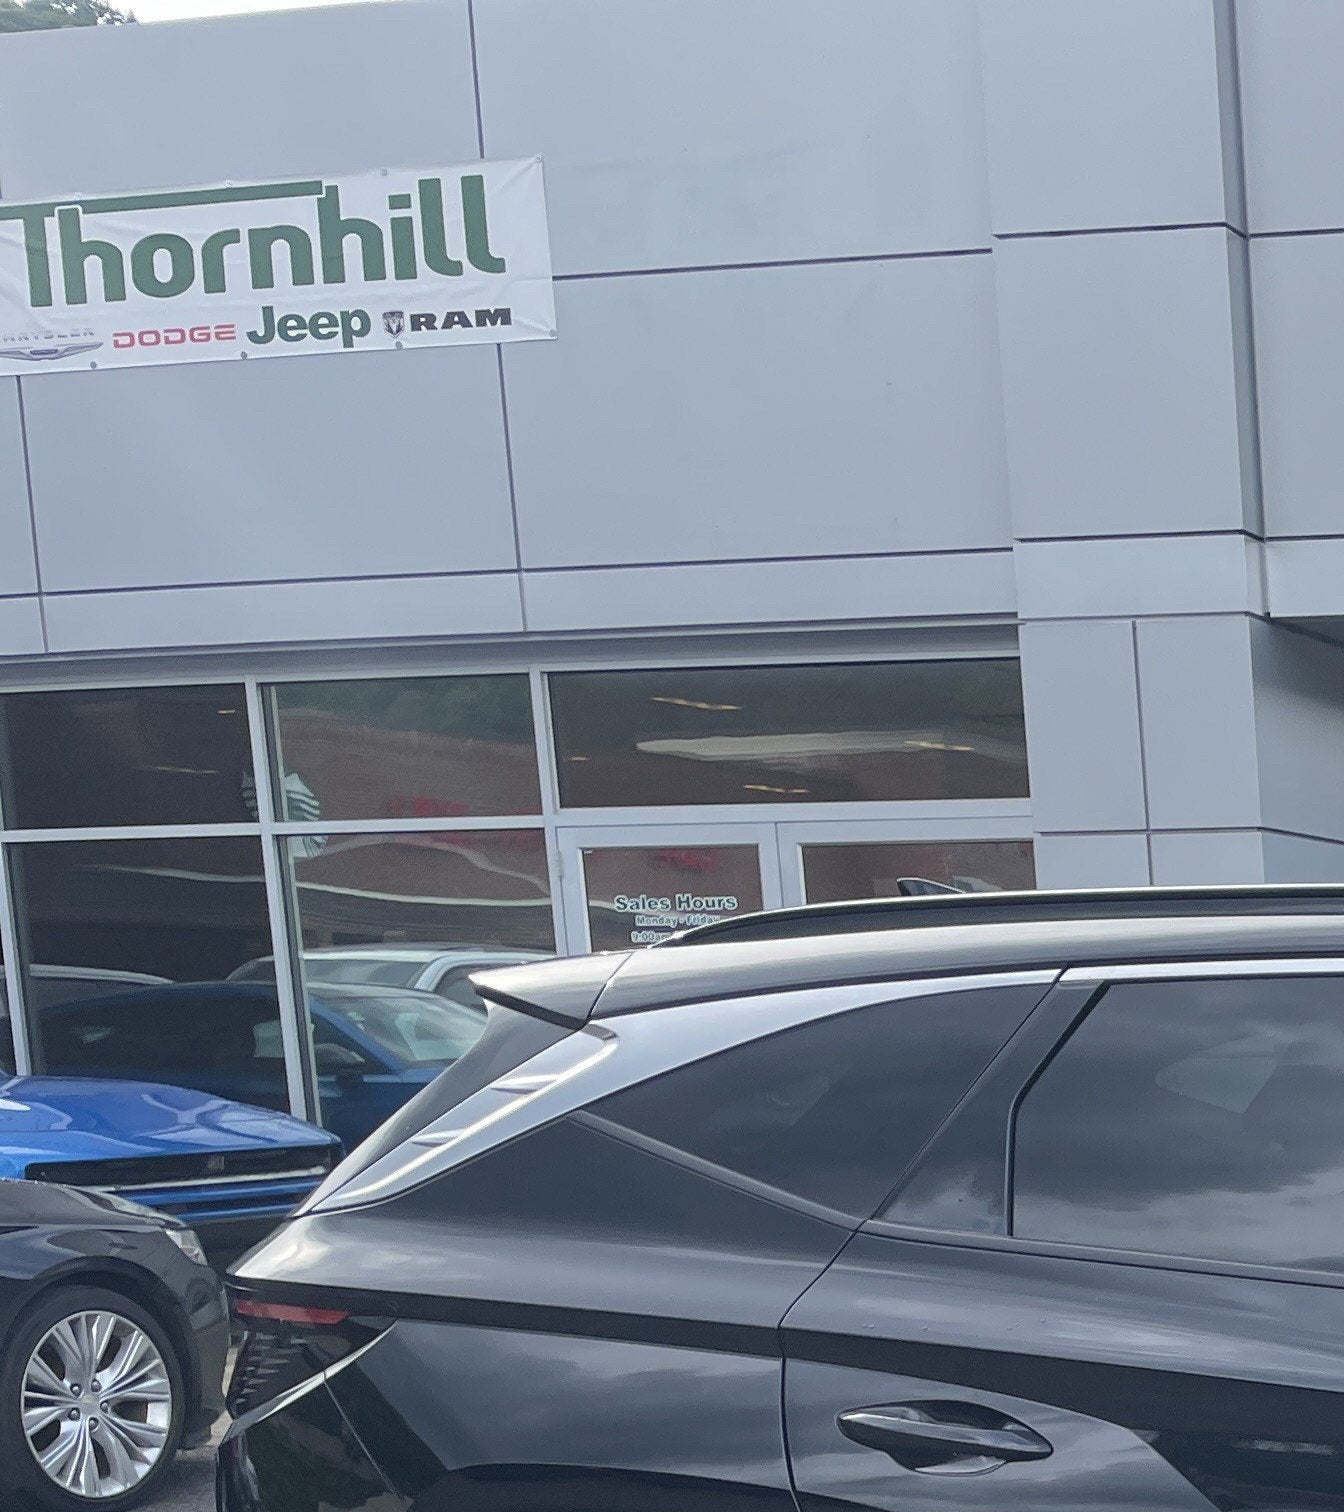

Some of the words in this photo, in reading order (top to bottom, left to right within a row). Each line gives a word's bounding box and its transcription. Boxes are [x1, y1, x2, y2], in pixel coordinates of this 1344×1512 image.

[0, 174, 507, 307] Thornhill
[246, 305, 372, 348] Jeep
[409, 307, 512, 332] RAM
[0, 326, 95, 342] HRYSLER
[112, 323, 237, 349] DODGE
[614, 894, 672, 912] Sales
[675, 893, 739, 911] Hours
[635, 915, 678, 928] Monday
